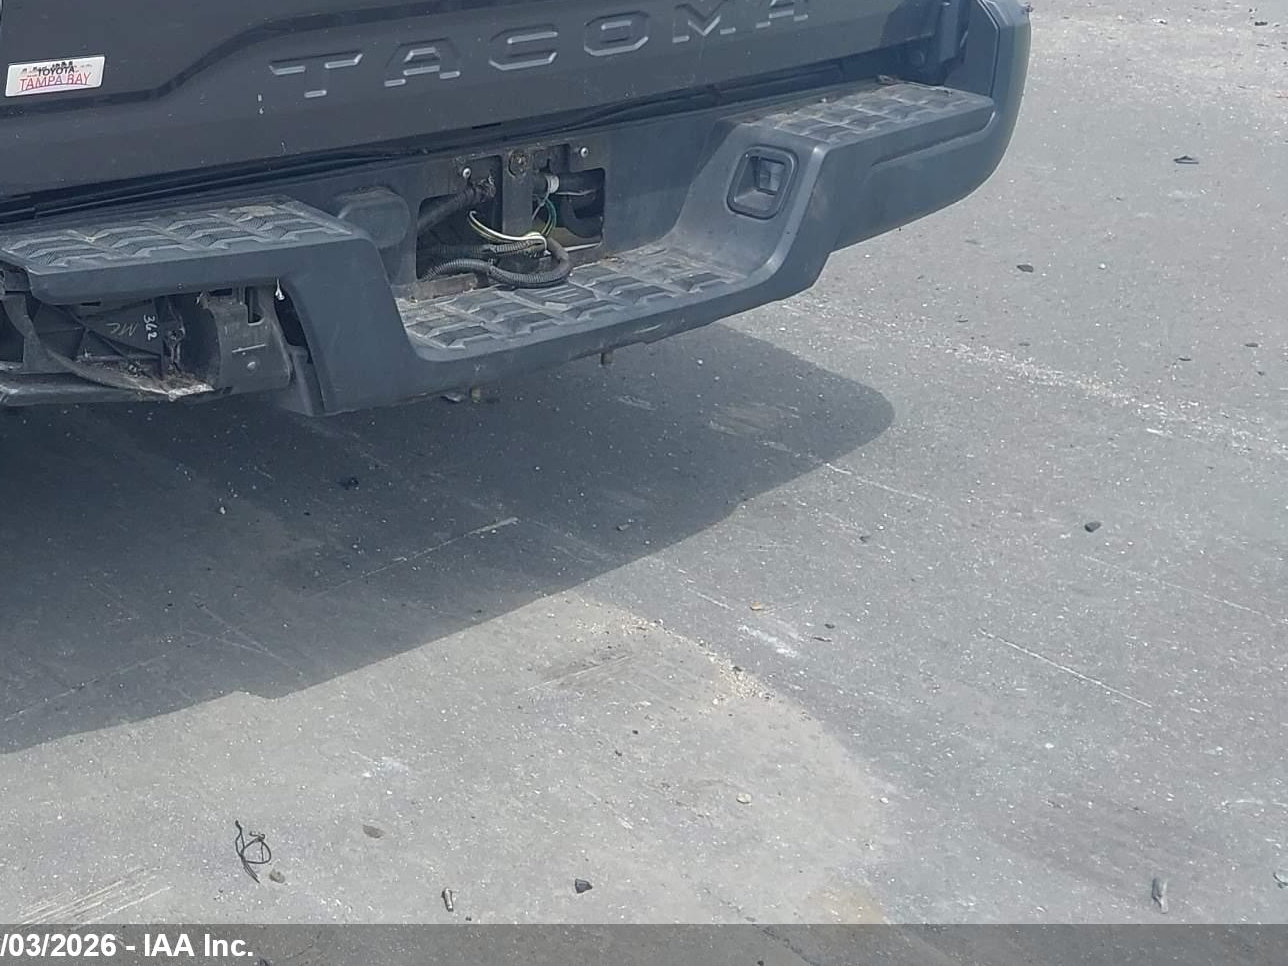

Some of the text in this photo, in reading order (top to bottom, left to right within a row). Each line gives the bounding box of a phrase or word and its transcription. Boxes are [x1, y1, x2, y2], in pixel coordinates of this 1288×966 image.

[38, 66, 75, 76] TOYOTA
[20, 72, 91, 91] TAMPA BAY
